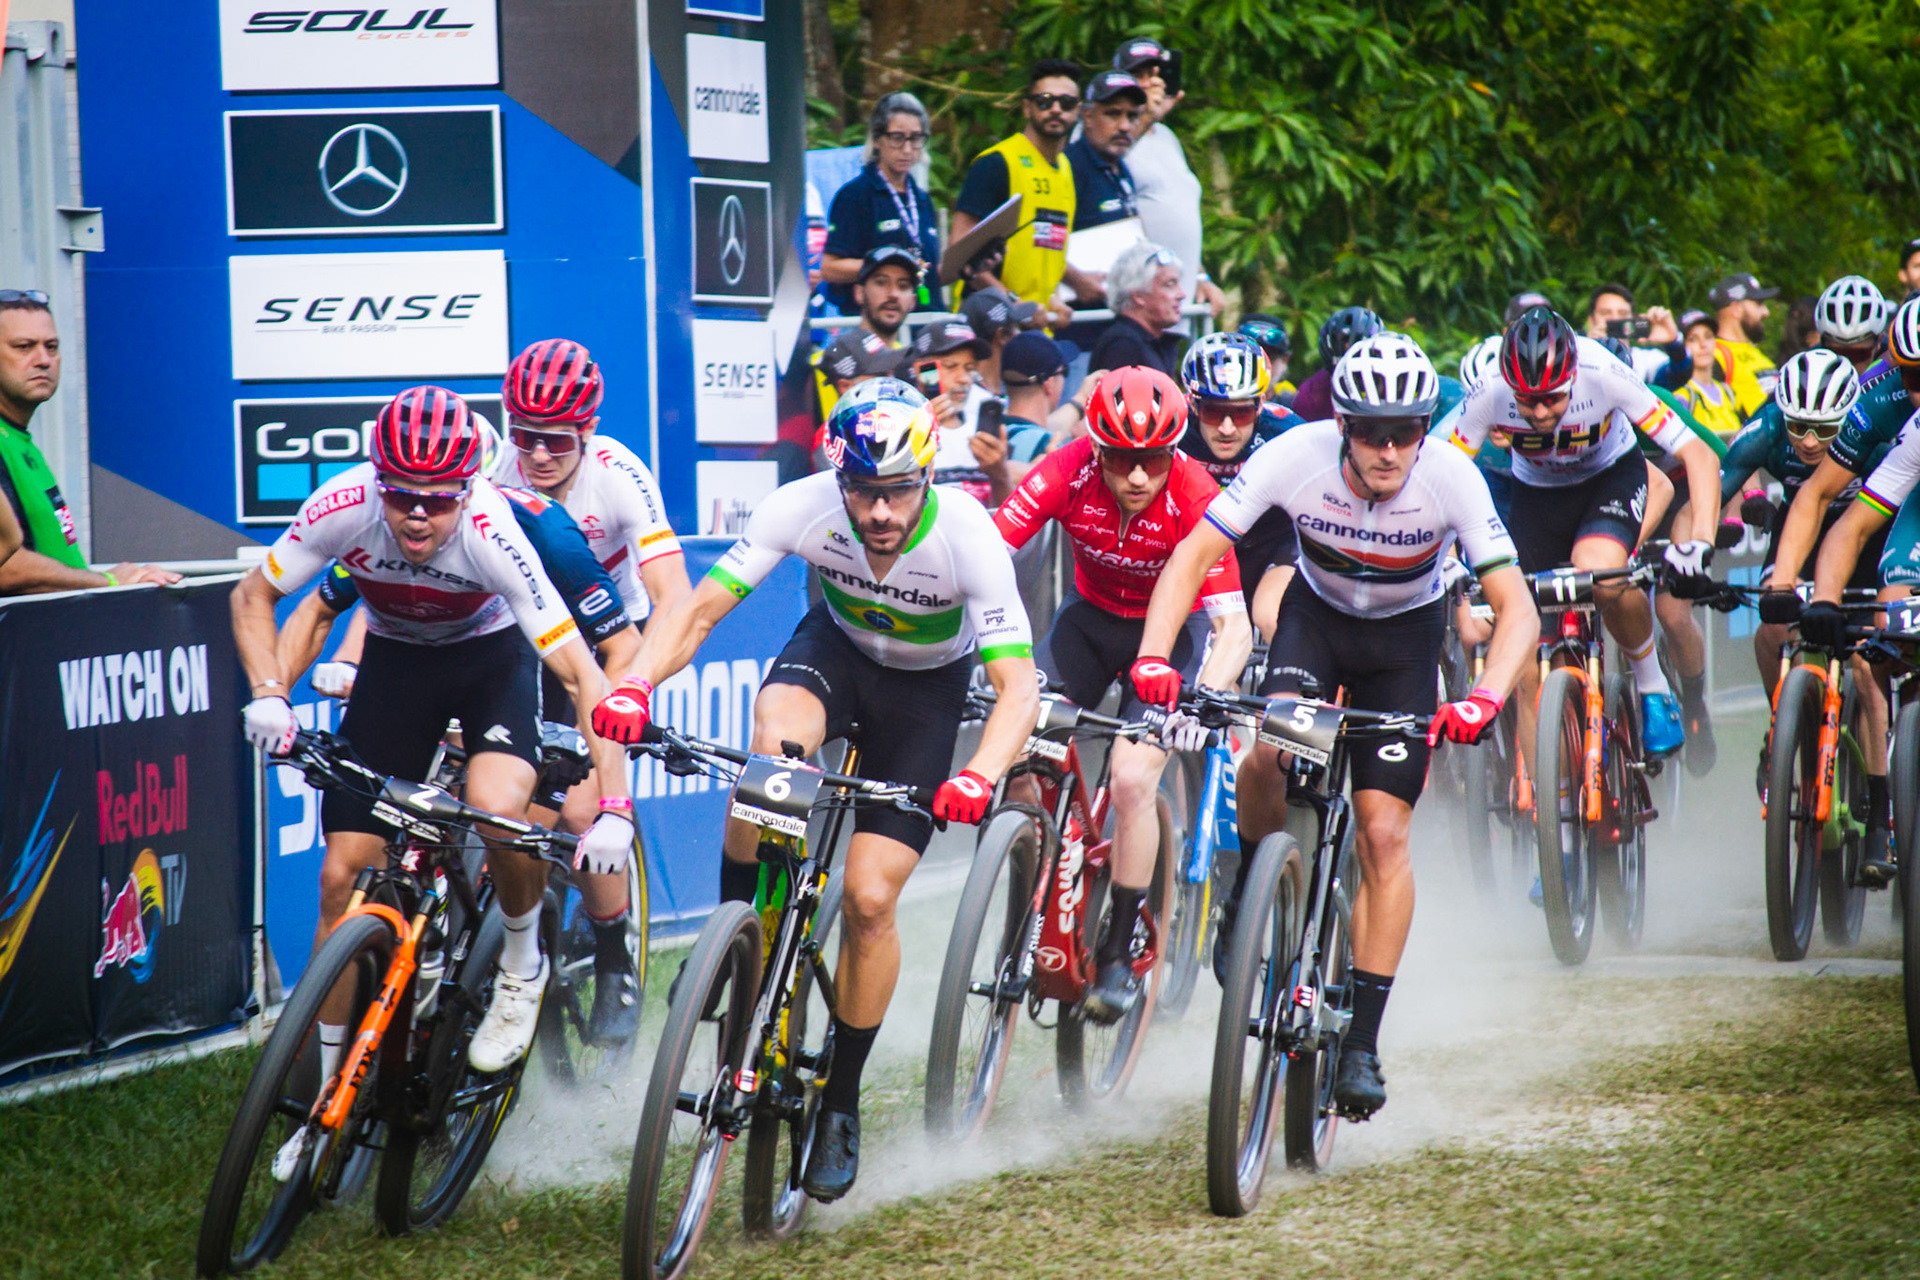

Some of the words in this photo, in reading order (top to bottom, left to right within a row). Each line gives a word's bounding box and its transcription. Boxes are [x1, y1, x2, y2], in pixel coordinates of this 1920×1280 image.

[243, 8, 475, 33] SOUL
[357, 31, 471, 40] CYCLES
[694, 83, 761, 116] cannondale
[1033, 178, 1050, 194] 33
[255, 294, 482, 323] SENSE
[322, 325, 346, 334] BIKE
[350, 324, 397, 333] PASSION
[704, 363, 768, 388] SENSE
[308, 486, 364, 520] ORLEN
[614, 459, 660, 524] KROSS
[1322, 503, 1353, 517] TOYOTA
[1297, 513, 1434, 546] cannondale
[375, 559, 485, 591] KROSS
[491, 532, 547, 611] KROSS
[1552, 576, 1577, 602] 11
[59, 649, 164, 731] WATCH
[169, 644, 210, 716] ON
[1289, 705, 1317, 733] 5
[1260, 734, 1326, 761] cannondale
[97, 761, 144, 845] Red
[145, 755, 188, 836] Bull
[764, 771, 792, 802] 6
[733, 806, 804, 833] cannondale
